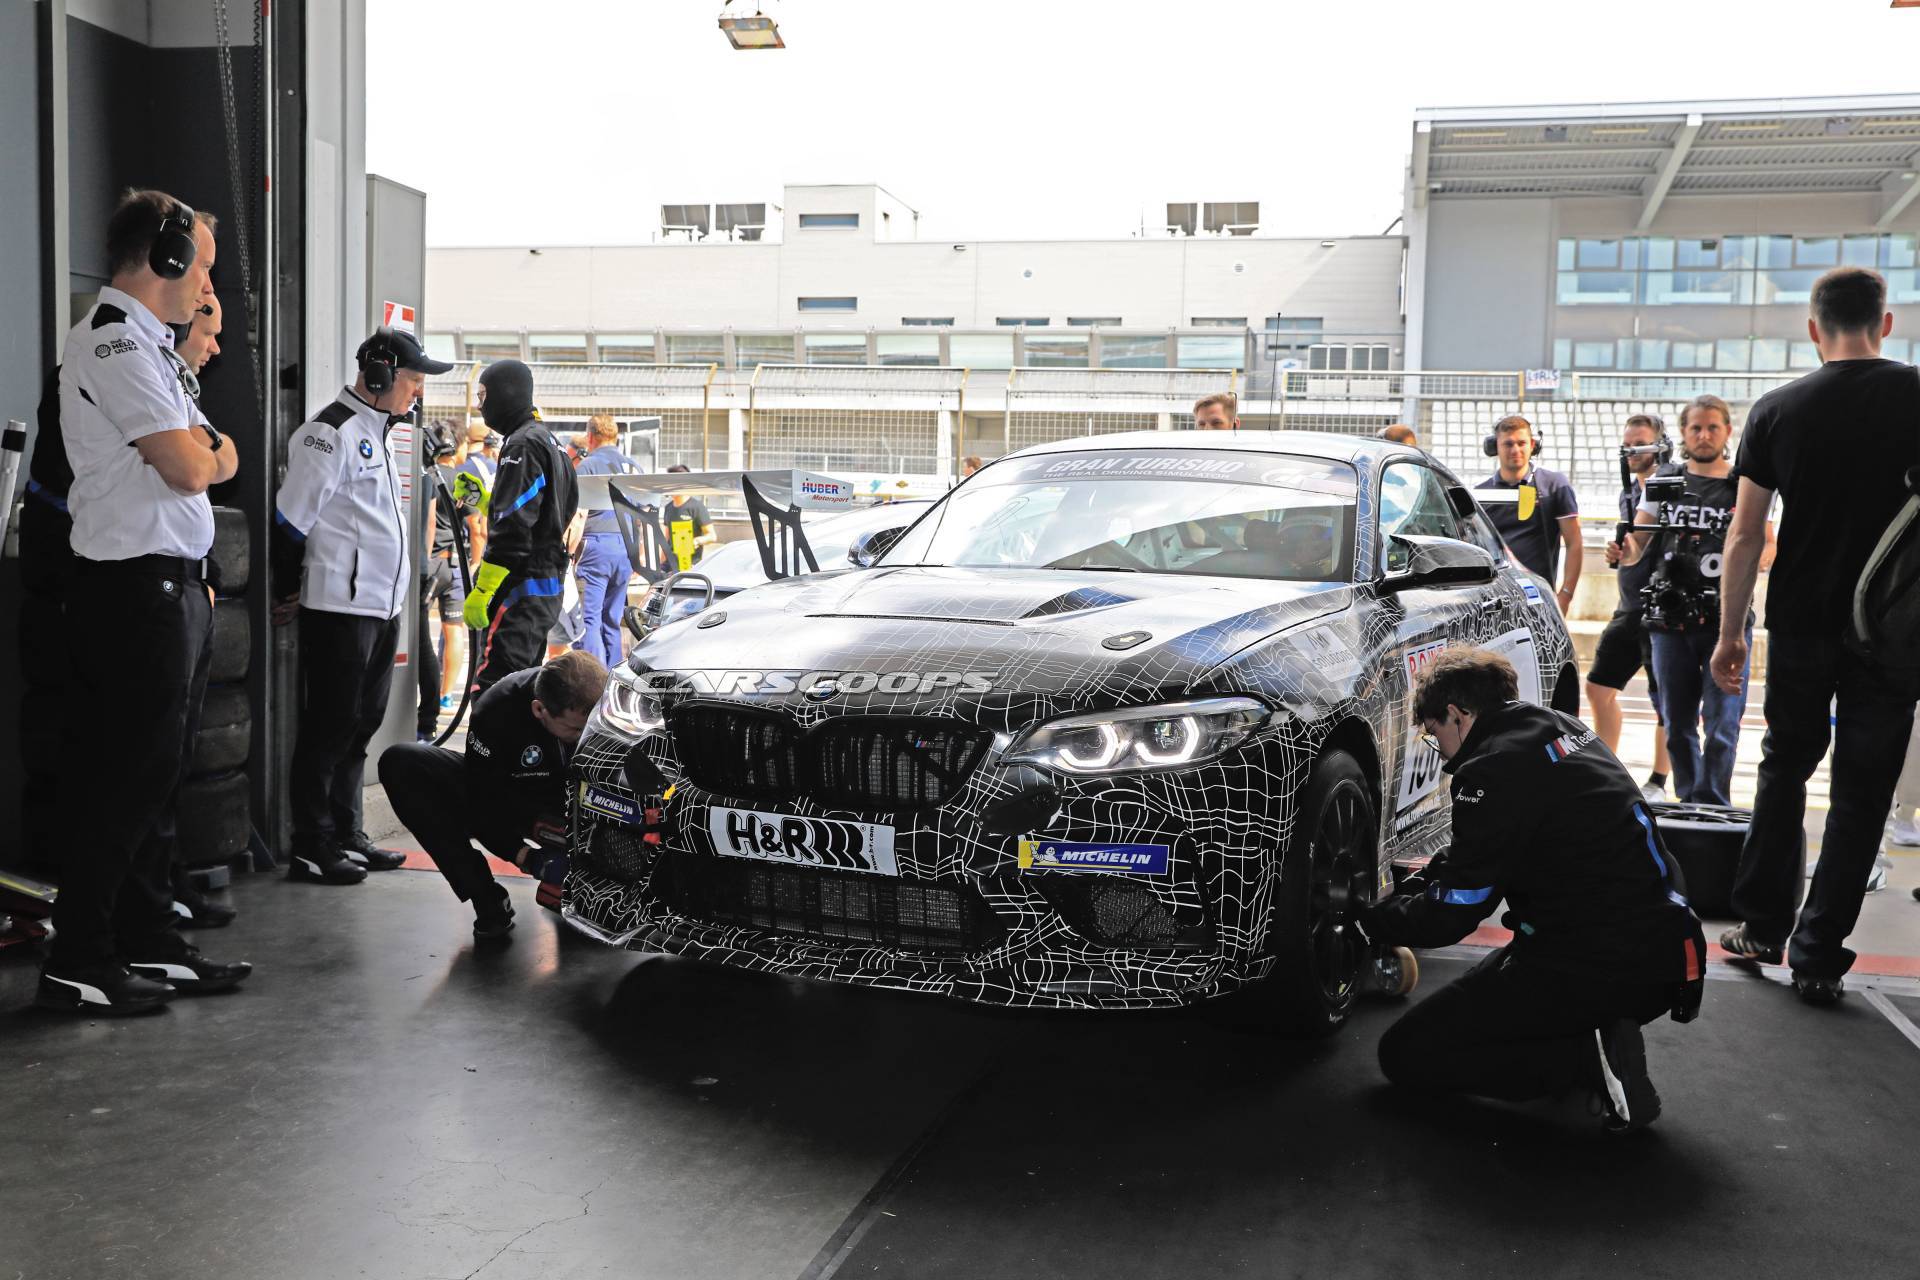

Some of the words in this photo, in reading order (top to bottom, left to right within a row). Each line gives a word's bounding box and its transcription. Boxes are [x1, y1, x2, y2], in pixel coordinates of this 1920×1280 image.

[112, 341, 136, 349] HELIX
[114, 346, 138, 354] ULTRA
[1046, 458, 1123, 473] GRAN
[1122, 457, 1244, 473] TURISMO
[1156, 470, 1230, 479] SIMULATOR
[802, 482, 839, 495] HUBER
[812, 494, 849, 504] Motorsport
[1312, 649, 1354, 670] solutions
[593, 795, 633, 815] MICHELIN
[1061, 850, 1151, 865] MICHELIN
